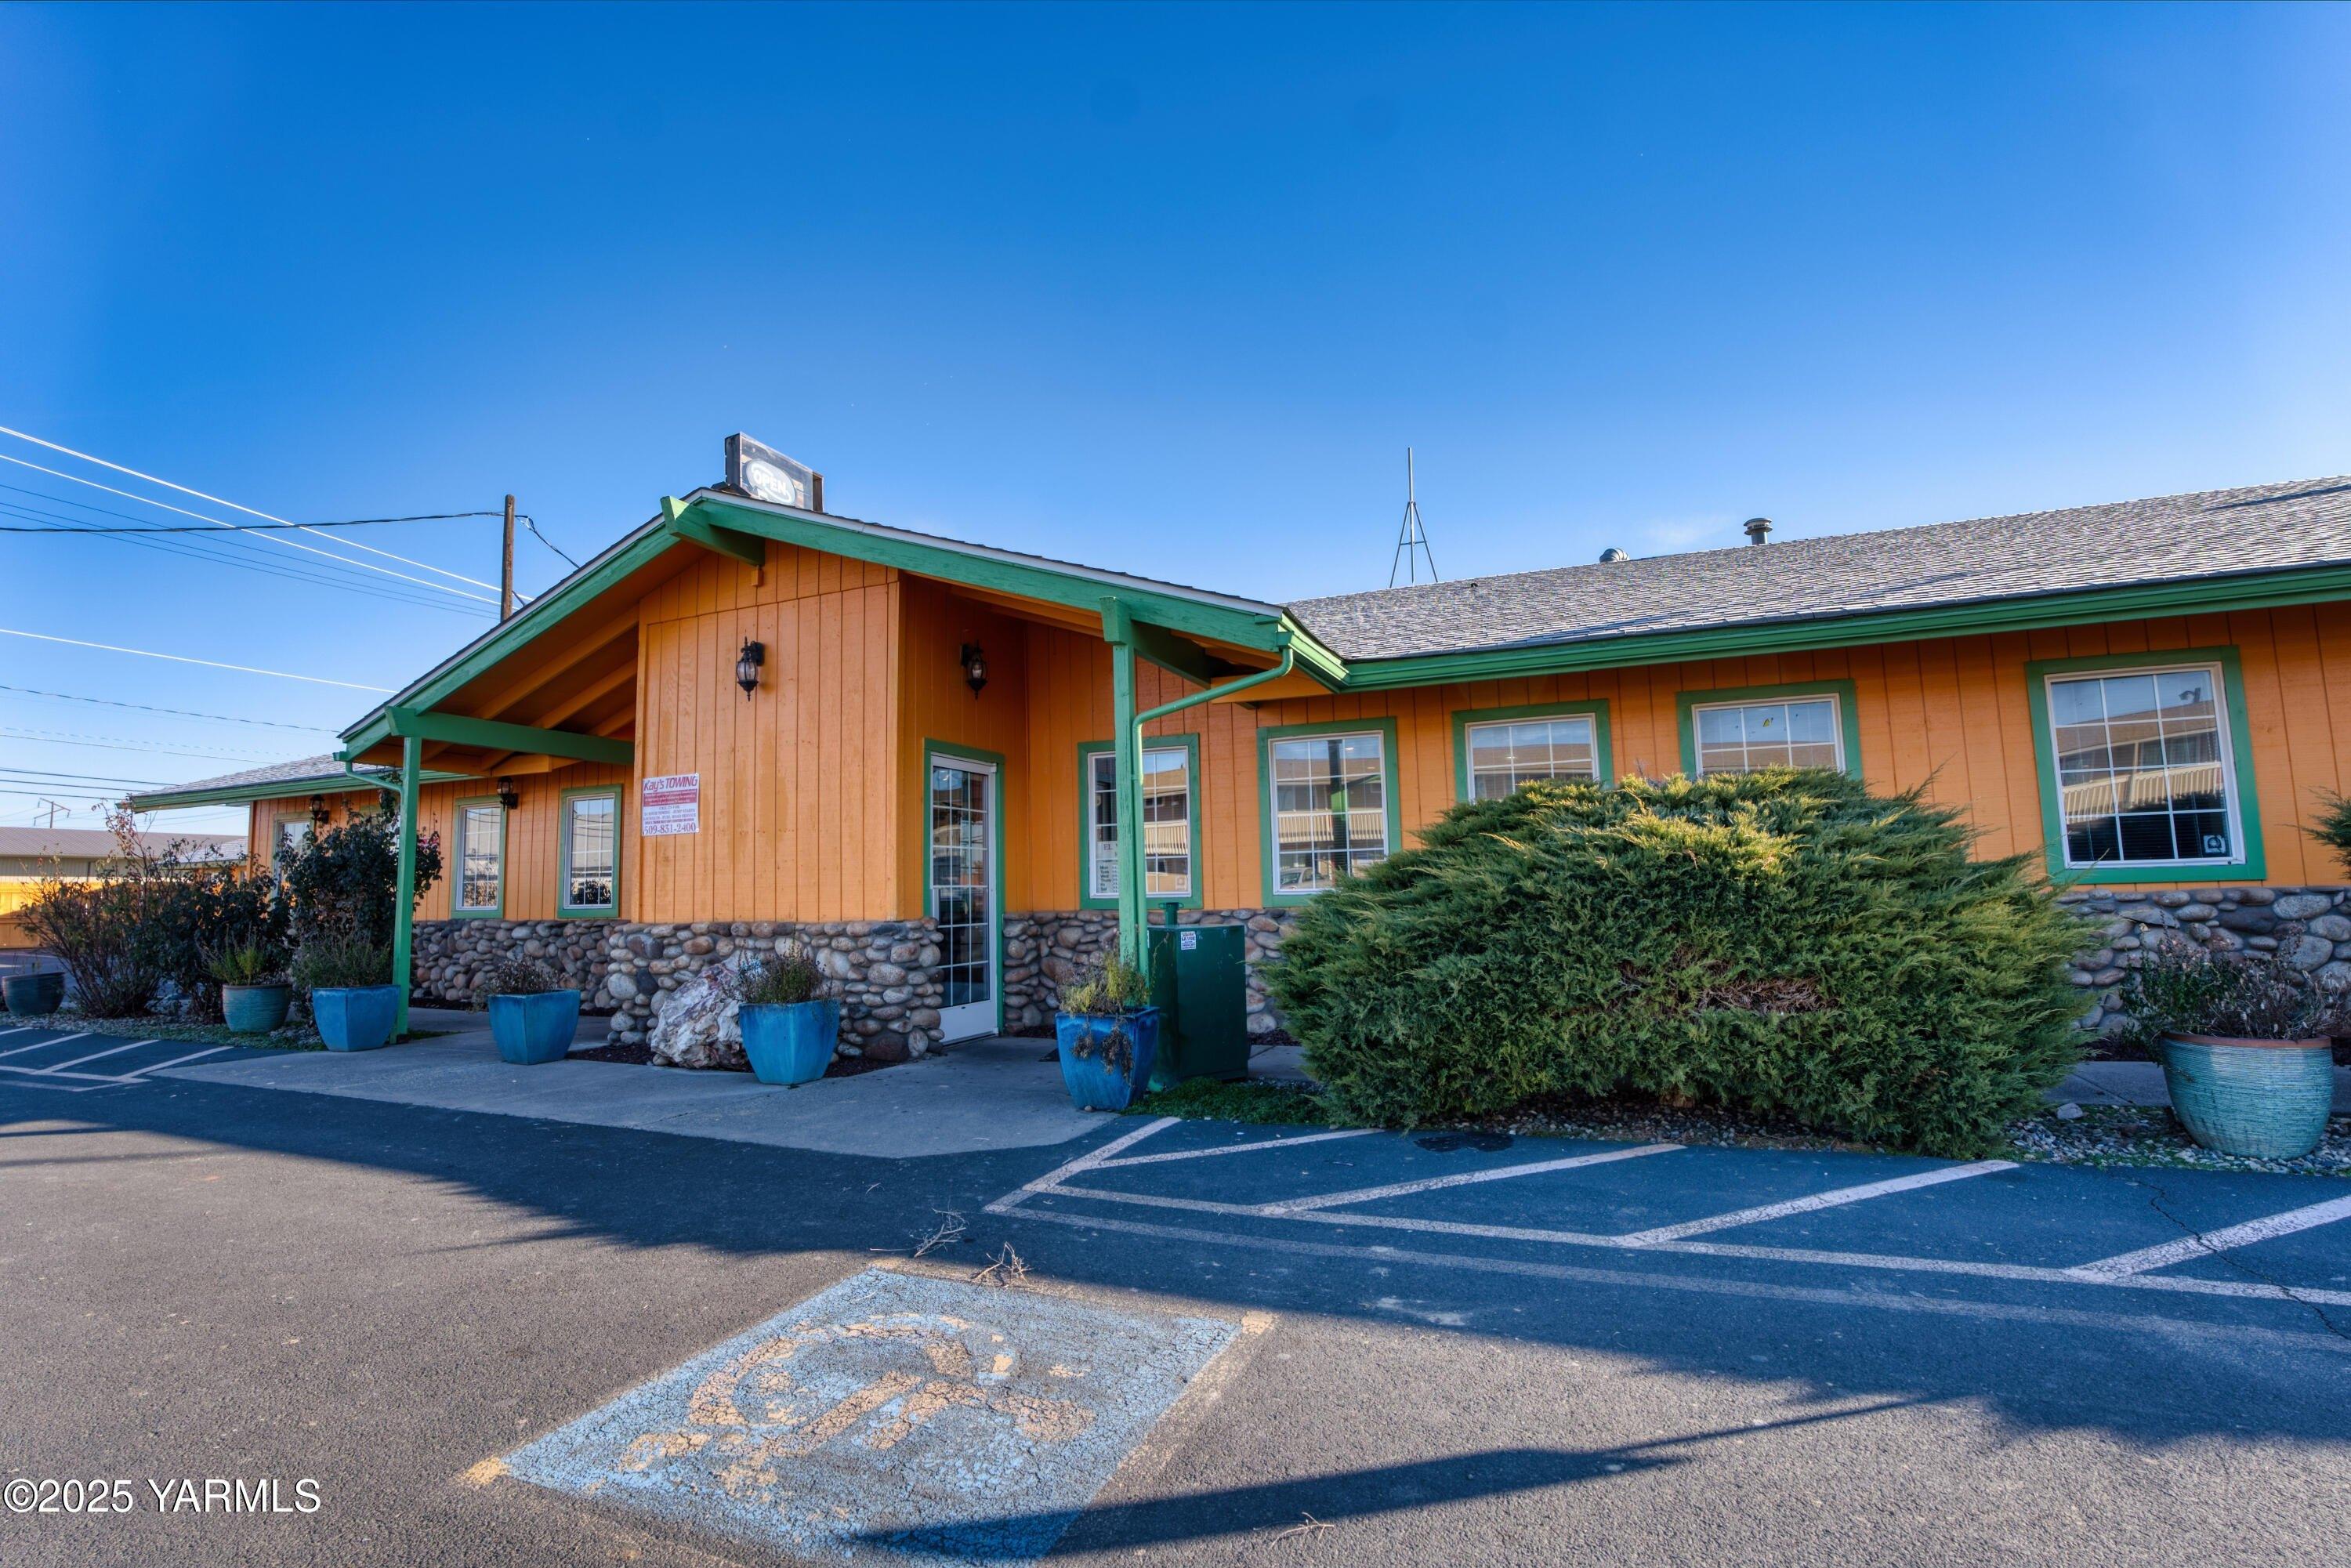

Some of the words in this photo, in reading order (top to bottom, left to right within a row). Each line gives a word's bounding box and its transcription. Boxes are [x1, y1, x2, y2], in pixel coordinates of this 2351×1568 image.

[753, 469, 787, 496] OPEN
[643, 779, 665, 792] Kay's
[665, 776, 698, 789] TOWING
